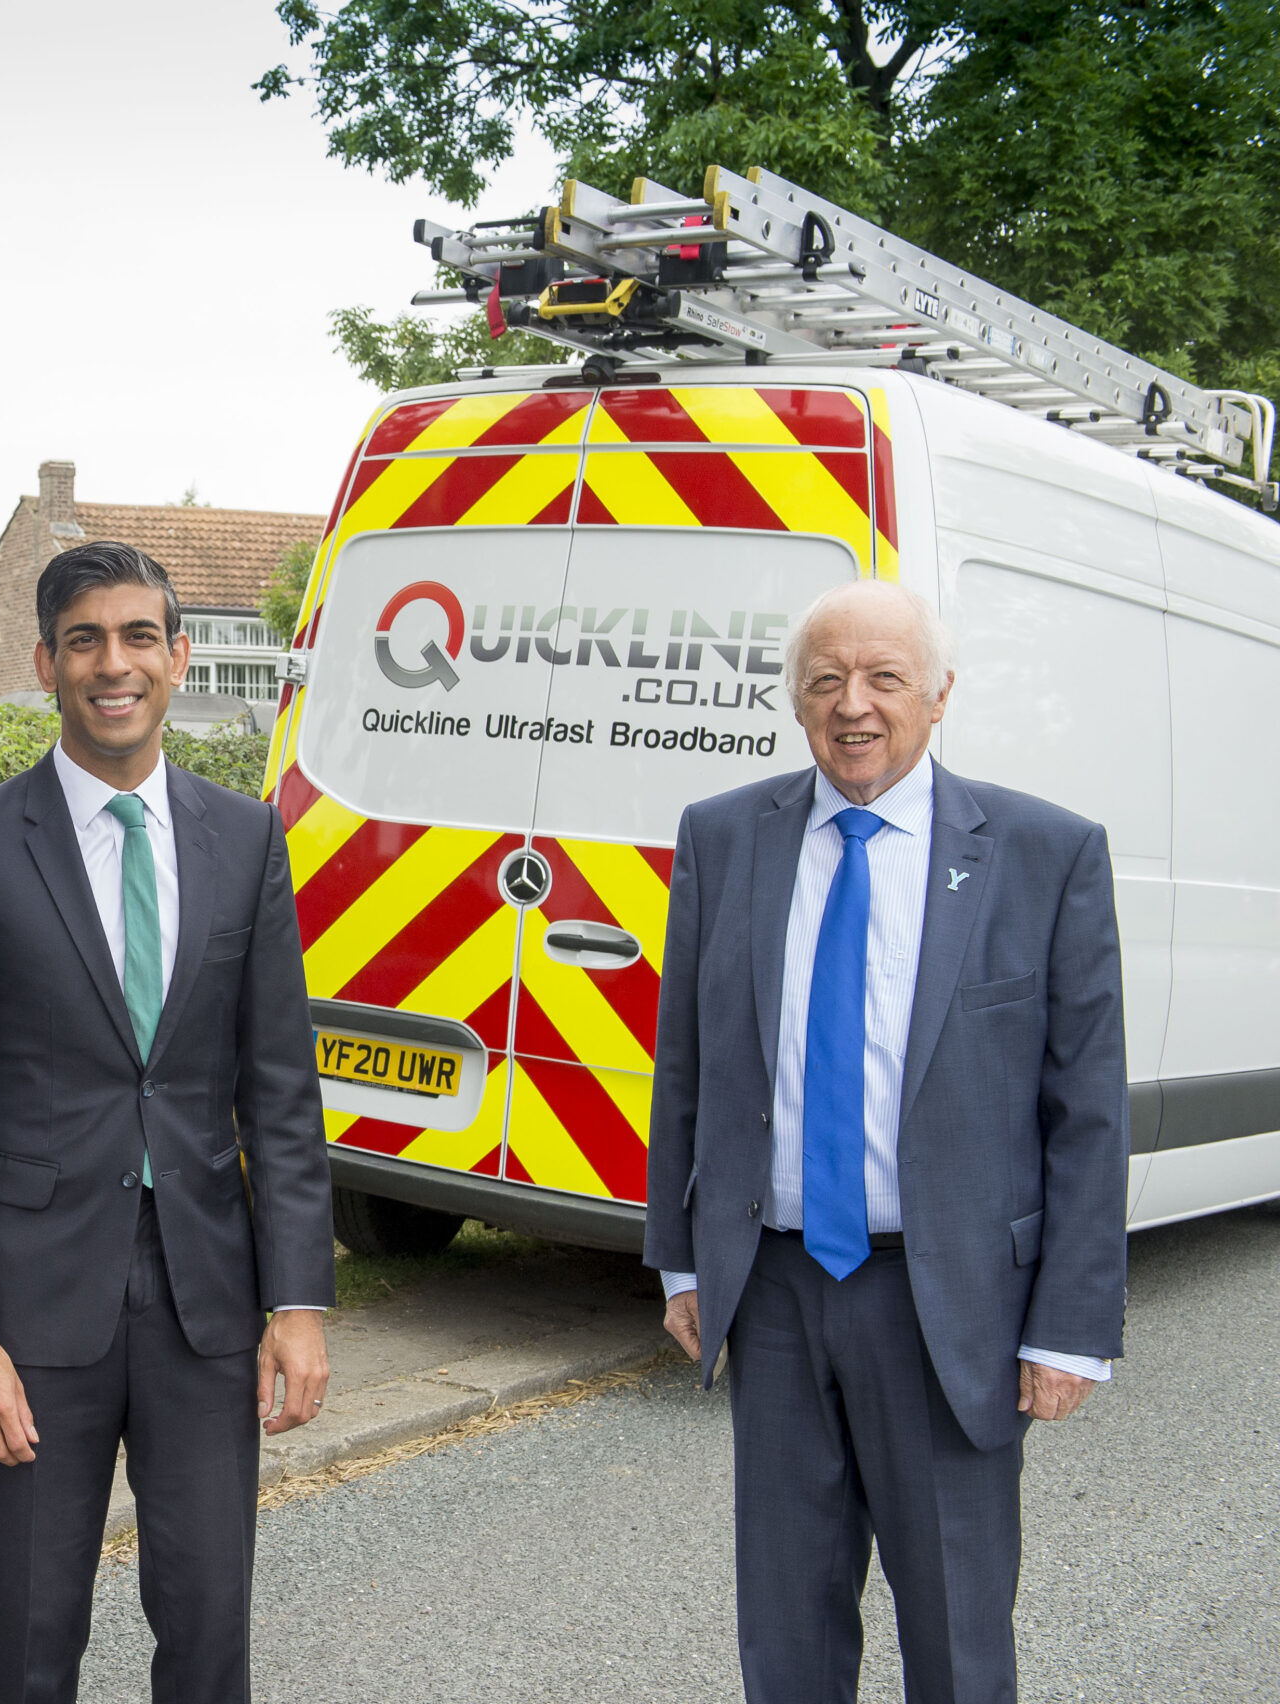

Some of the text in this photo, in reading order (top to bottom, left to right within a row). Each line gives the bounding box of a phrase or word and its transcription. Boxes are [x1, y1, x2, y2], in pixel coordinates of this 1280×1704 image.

[686, 306, 703, 322] Rhino
[915, 290, 938, 318] LYTE
[374, 580, 789, 692] QUICKLINE
[622, 678, 779, 711] .CO.UK
[362, 708, 776, 757] Quickline Ultrafast Broadband
[947, 868, 970, 891] Y
[322, 1037, 455, 1090] YF20 UWR
